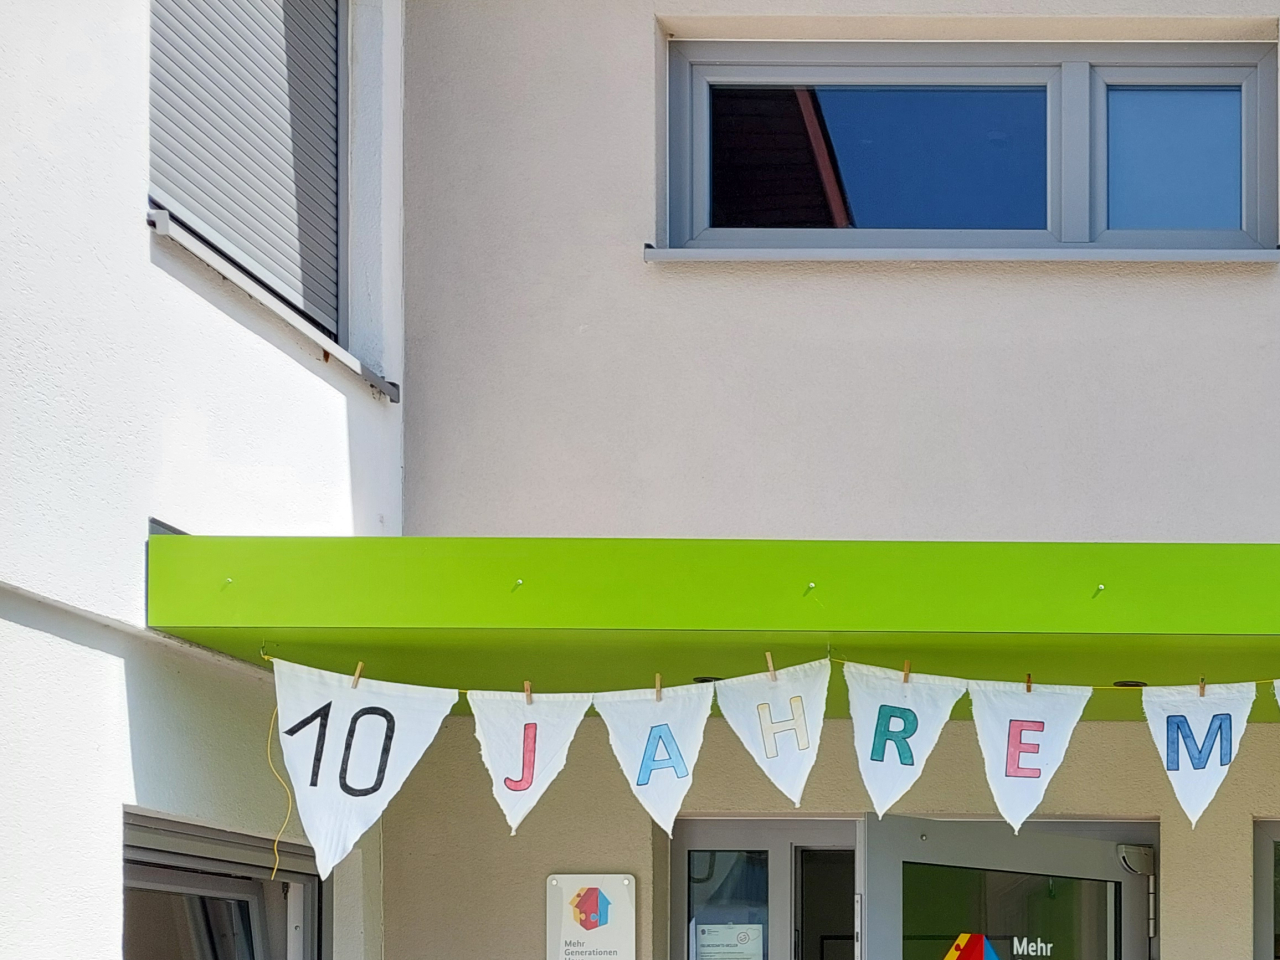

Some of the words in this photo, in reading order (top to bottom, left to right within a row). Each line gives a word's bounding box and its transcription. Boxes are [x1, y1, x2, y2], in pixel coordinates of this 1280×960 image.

[283, 700, 396, 797] 10
[564, 940, 586, 948] Mehr
[1012, 936, 1053, 956] Mehr
[564, 948, 618, 957] Generationen
